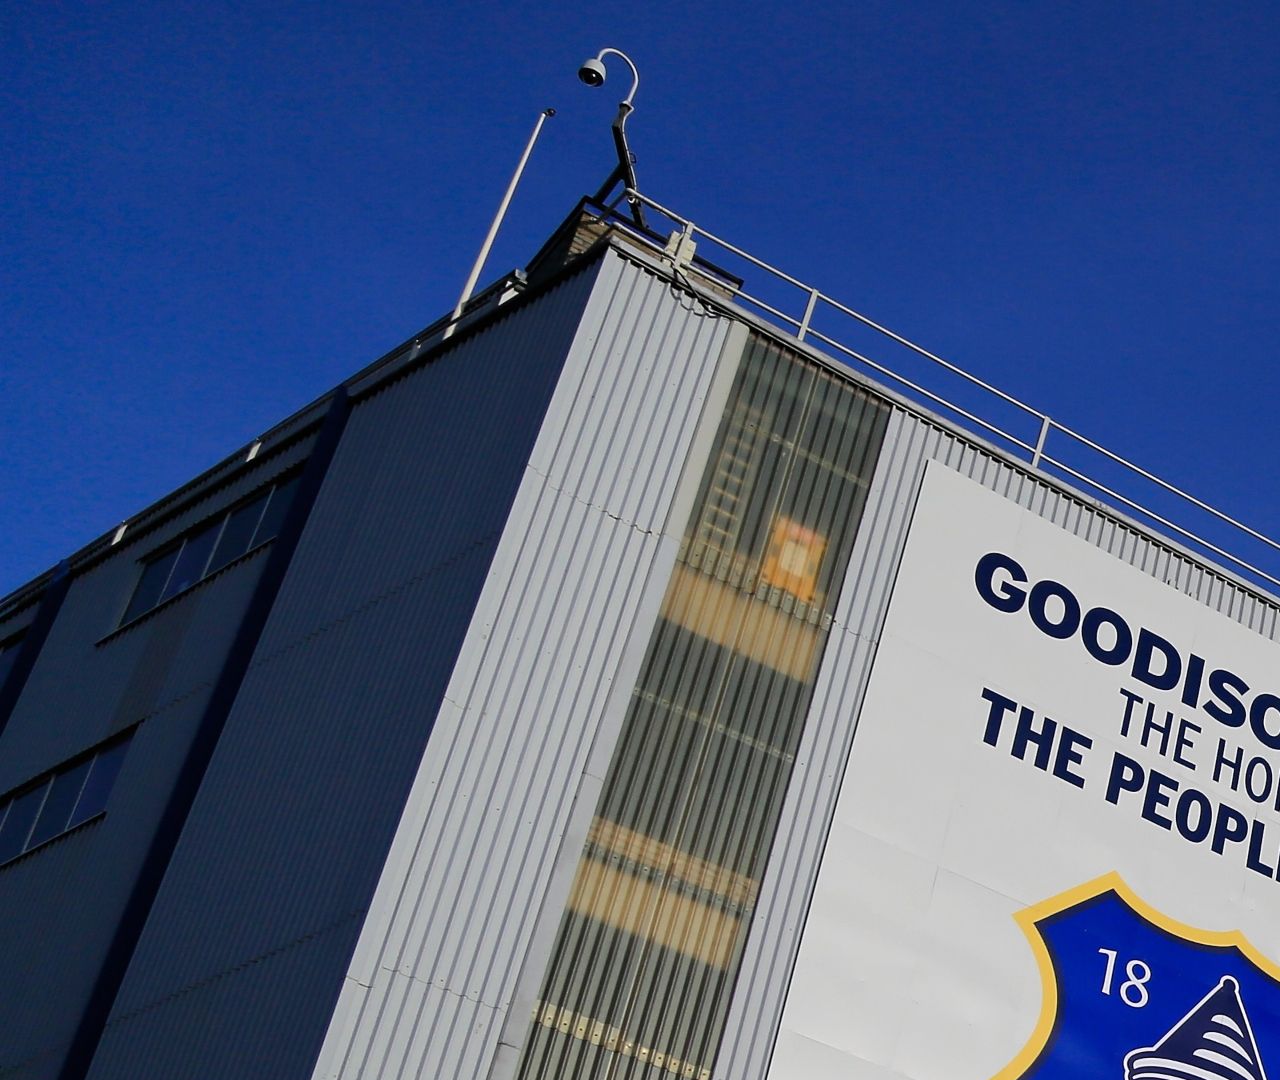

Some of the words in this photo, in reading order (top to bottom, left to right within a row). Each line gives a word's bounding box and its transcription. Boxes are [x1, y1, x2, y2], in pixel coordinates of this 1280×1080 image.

[980, 686, 1094, 790] THE
[1117, 687, 1202, 772] THE
[1097, 947, 1152, 1009] 18
